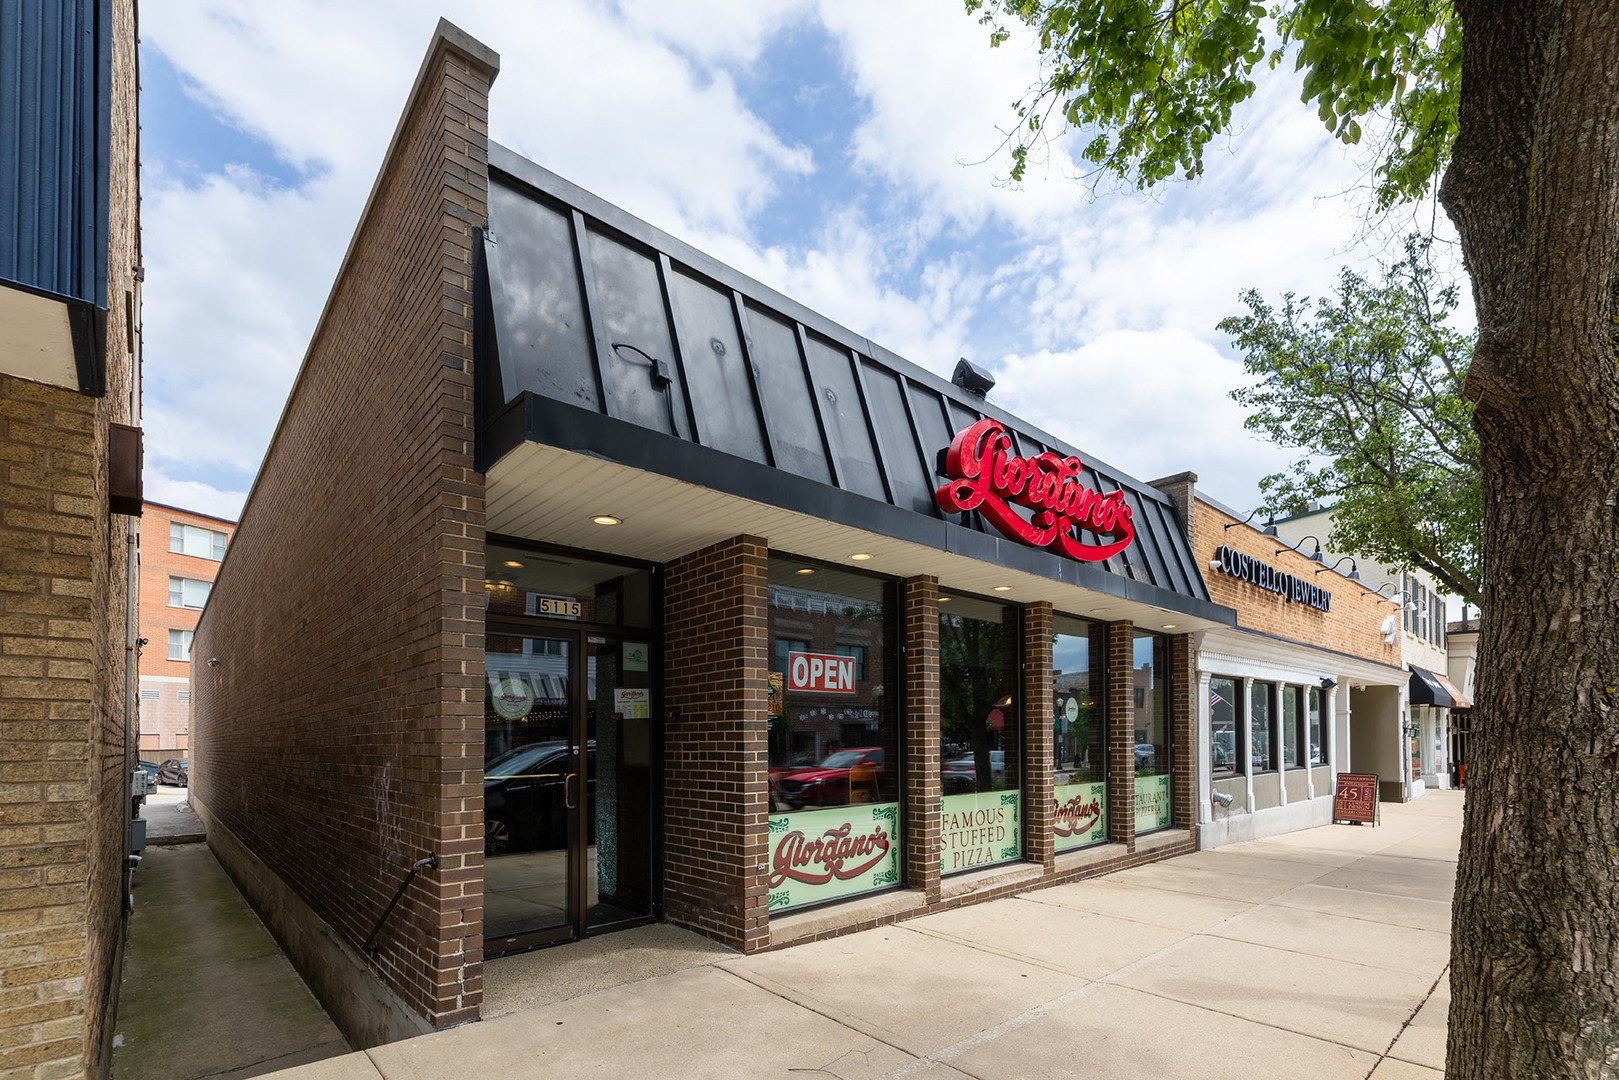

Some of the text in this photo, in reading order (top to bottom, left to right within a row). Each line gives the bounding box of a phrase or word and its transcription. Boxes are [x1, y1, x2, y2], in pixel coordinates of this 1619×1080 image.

[935, 417, 1135, 563] Giordano's
[1217, 544, 1332, 612] COSTELLO JEWELRY
[541, 600, 579, 615] 5115
[792, 656, 854, 690] OPEN
[1339, 787, 1358, 800] 45
[942, 807, 1004, 831] FAMOUS
[940, 825, 1006, 851] STUFFED
[769, 822, 889, 888] Giordano's
[953, 846, 994, 869] PIZZA
